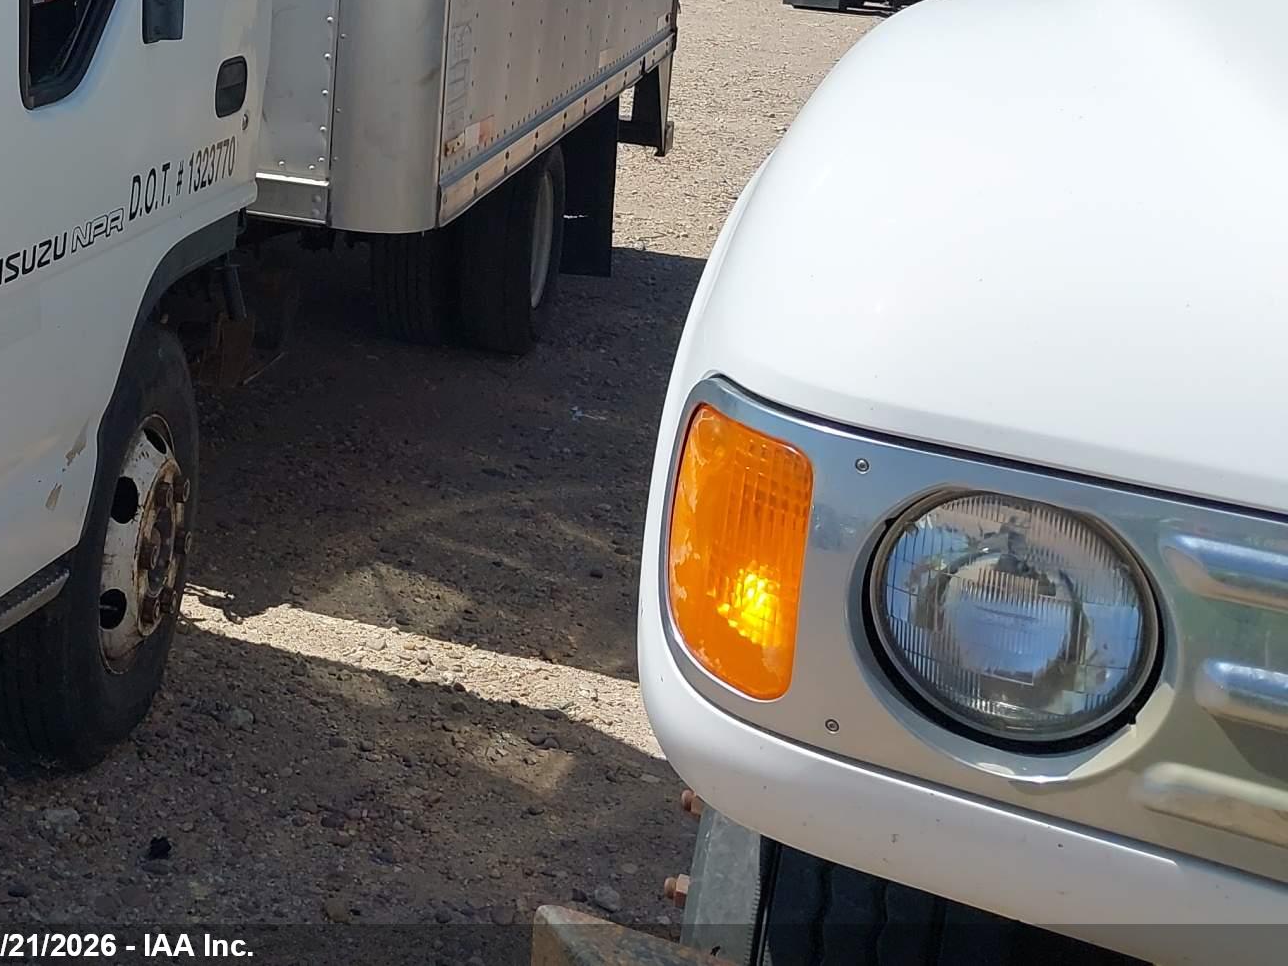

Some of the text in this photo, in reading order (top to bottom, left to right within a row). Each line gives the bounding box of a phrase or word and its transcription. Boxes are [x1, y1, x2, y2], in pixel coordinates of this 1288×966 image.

[129, 162, 171, 222] D.O.T.
[188, 136, 236, 195] 1323770
[71, 207, 124, 254] NPR
